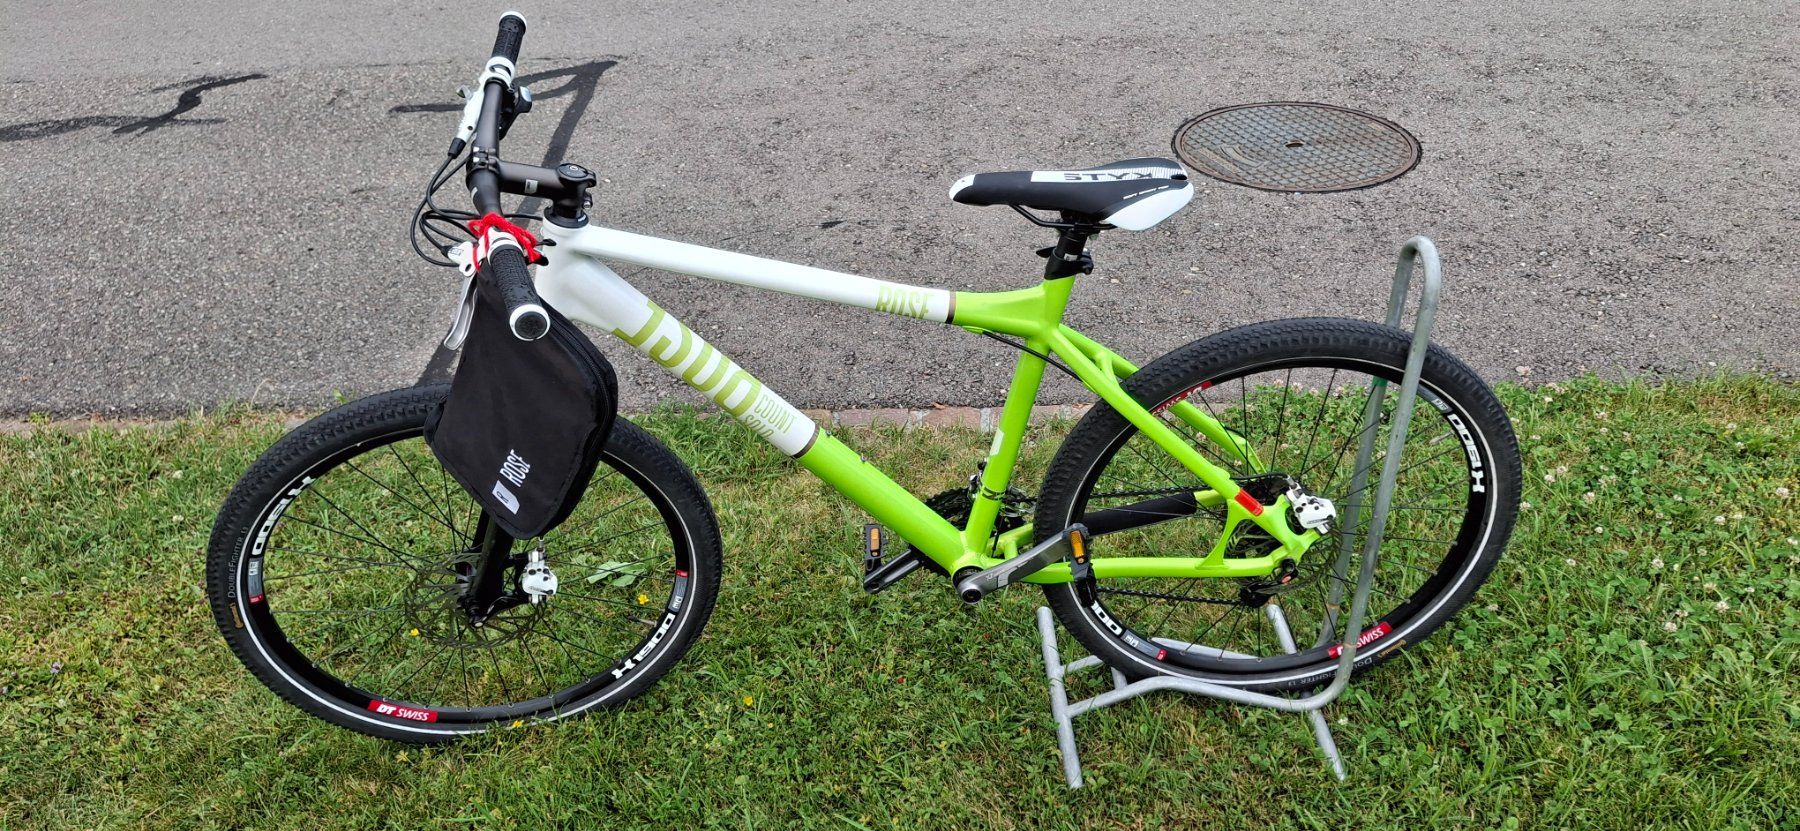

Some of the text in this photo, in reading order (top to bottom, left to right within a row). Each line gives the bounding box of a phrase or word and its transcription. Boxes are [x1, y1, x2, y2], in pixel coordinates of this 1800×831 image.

[1064, 172, 1153, 181] STYX
[876, 285, 933, 320] ROSE
[754, 394, 798, 434] COUNT
[499, 448, 531, 488] ROSE
[376, 703, 430, 721] DT SWISS
